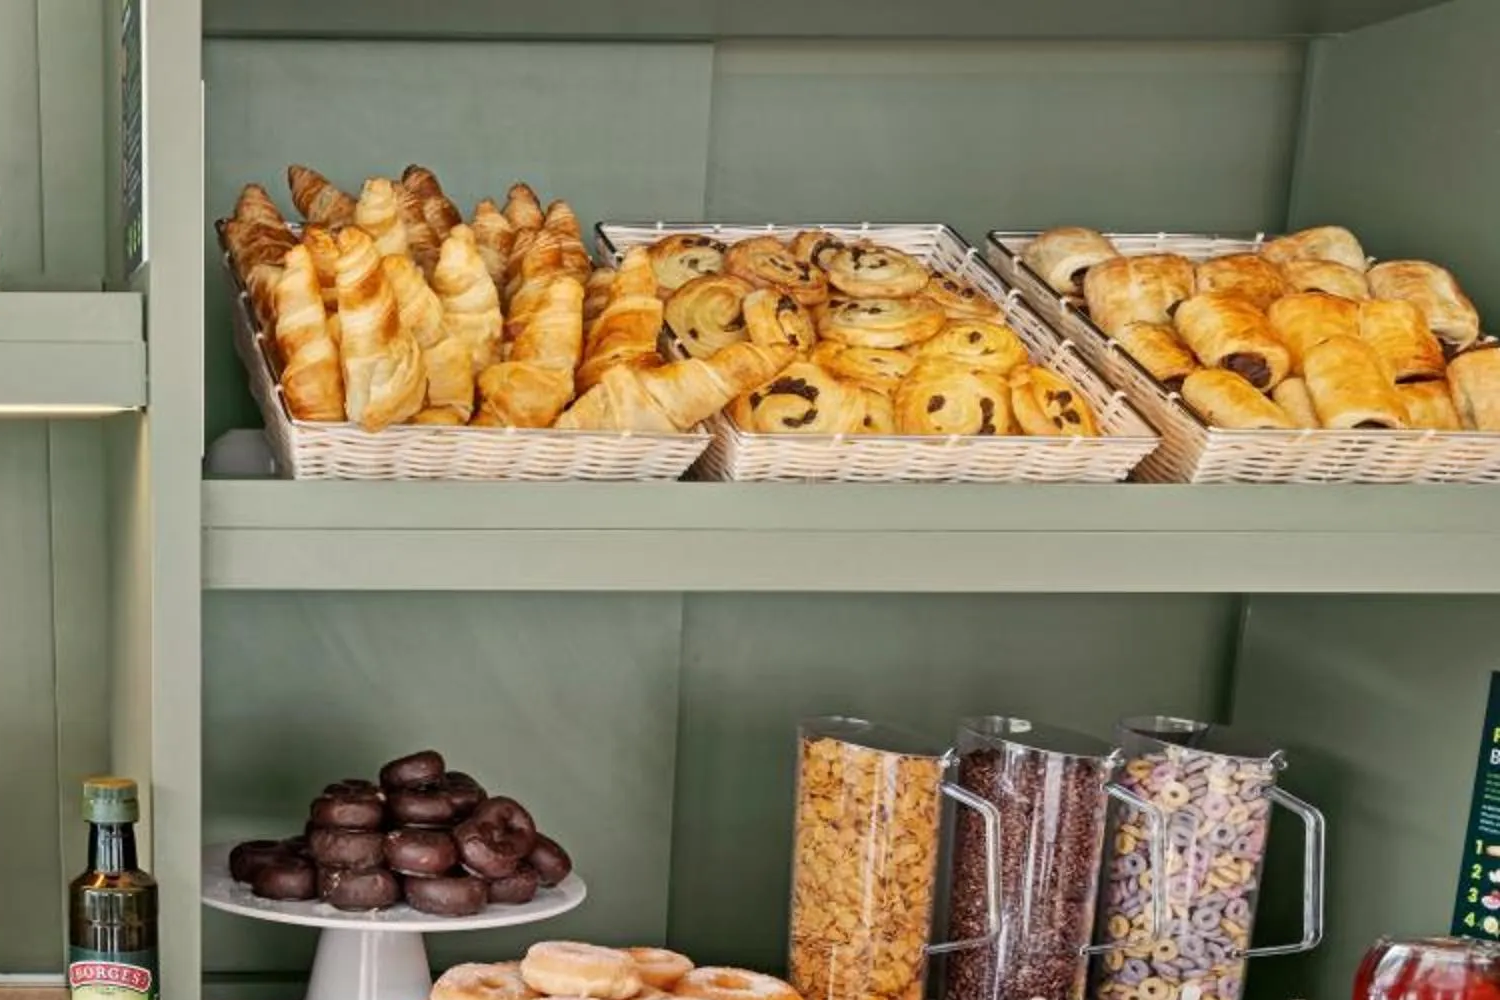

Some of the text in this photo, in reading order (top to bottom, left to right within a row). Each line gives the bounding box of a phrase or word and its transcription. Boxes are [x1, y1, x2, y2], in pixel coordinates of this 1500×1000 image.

[1475, 839, 1483, 855] 1
[1471, 863, 1482, 880] 2
[1468, 887, 1478, 903] 3
[1464, 912, 1475, 927] 4
[74, 966, 140, 984] BORGES
